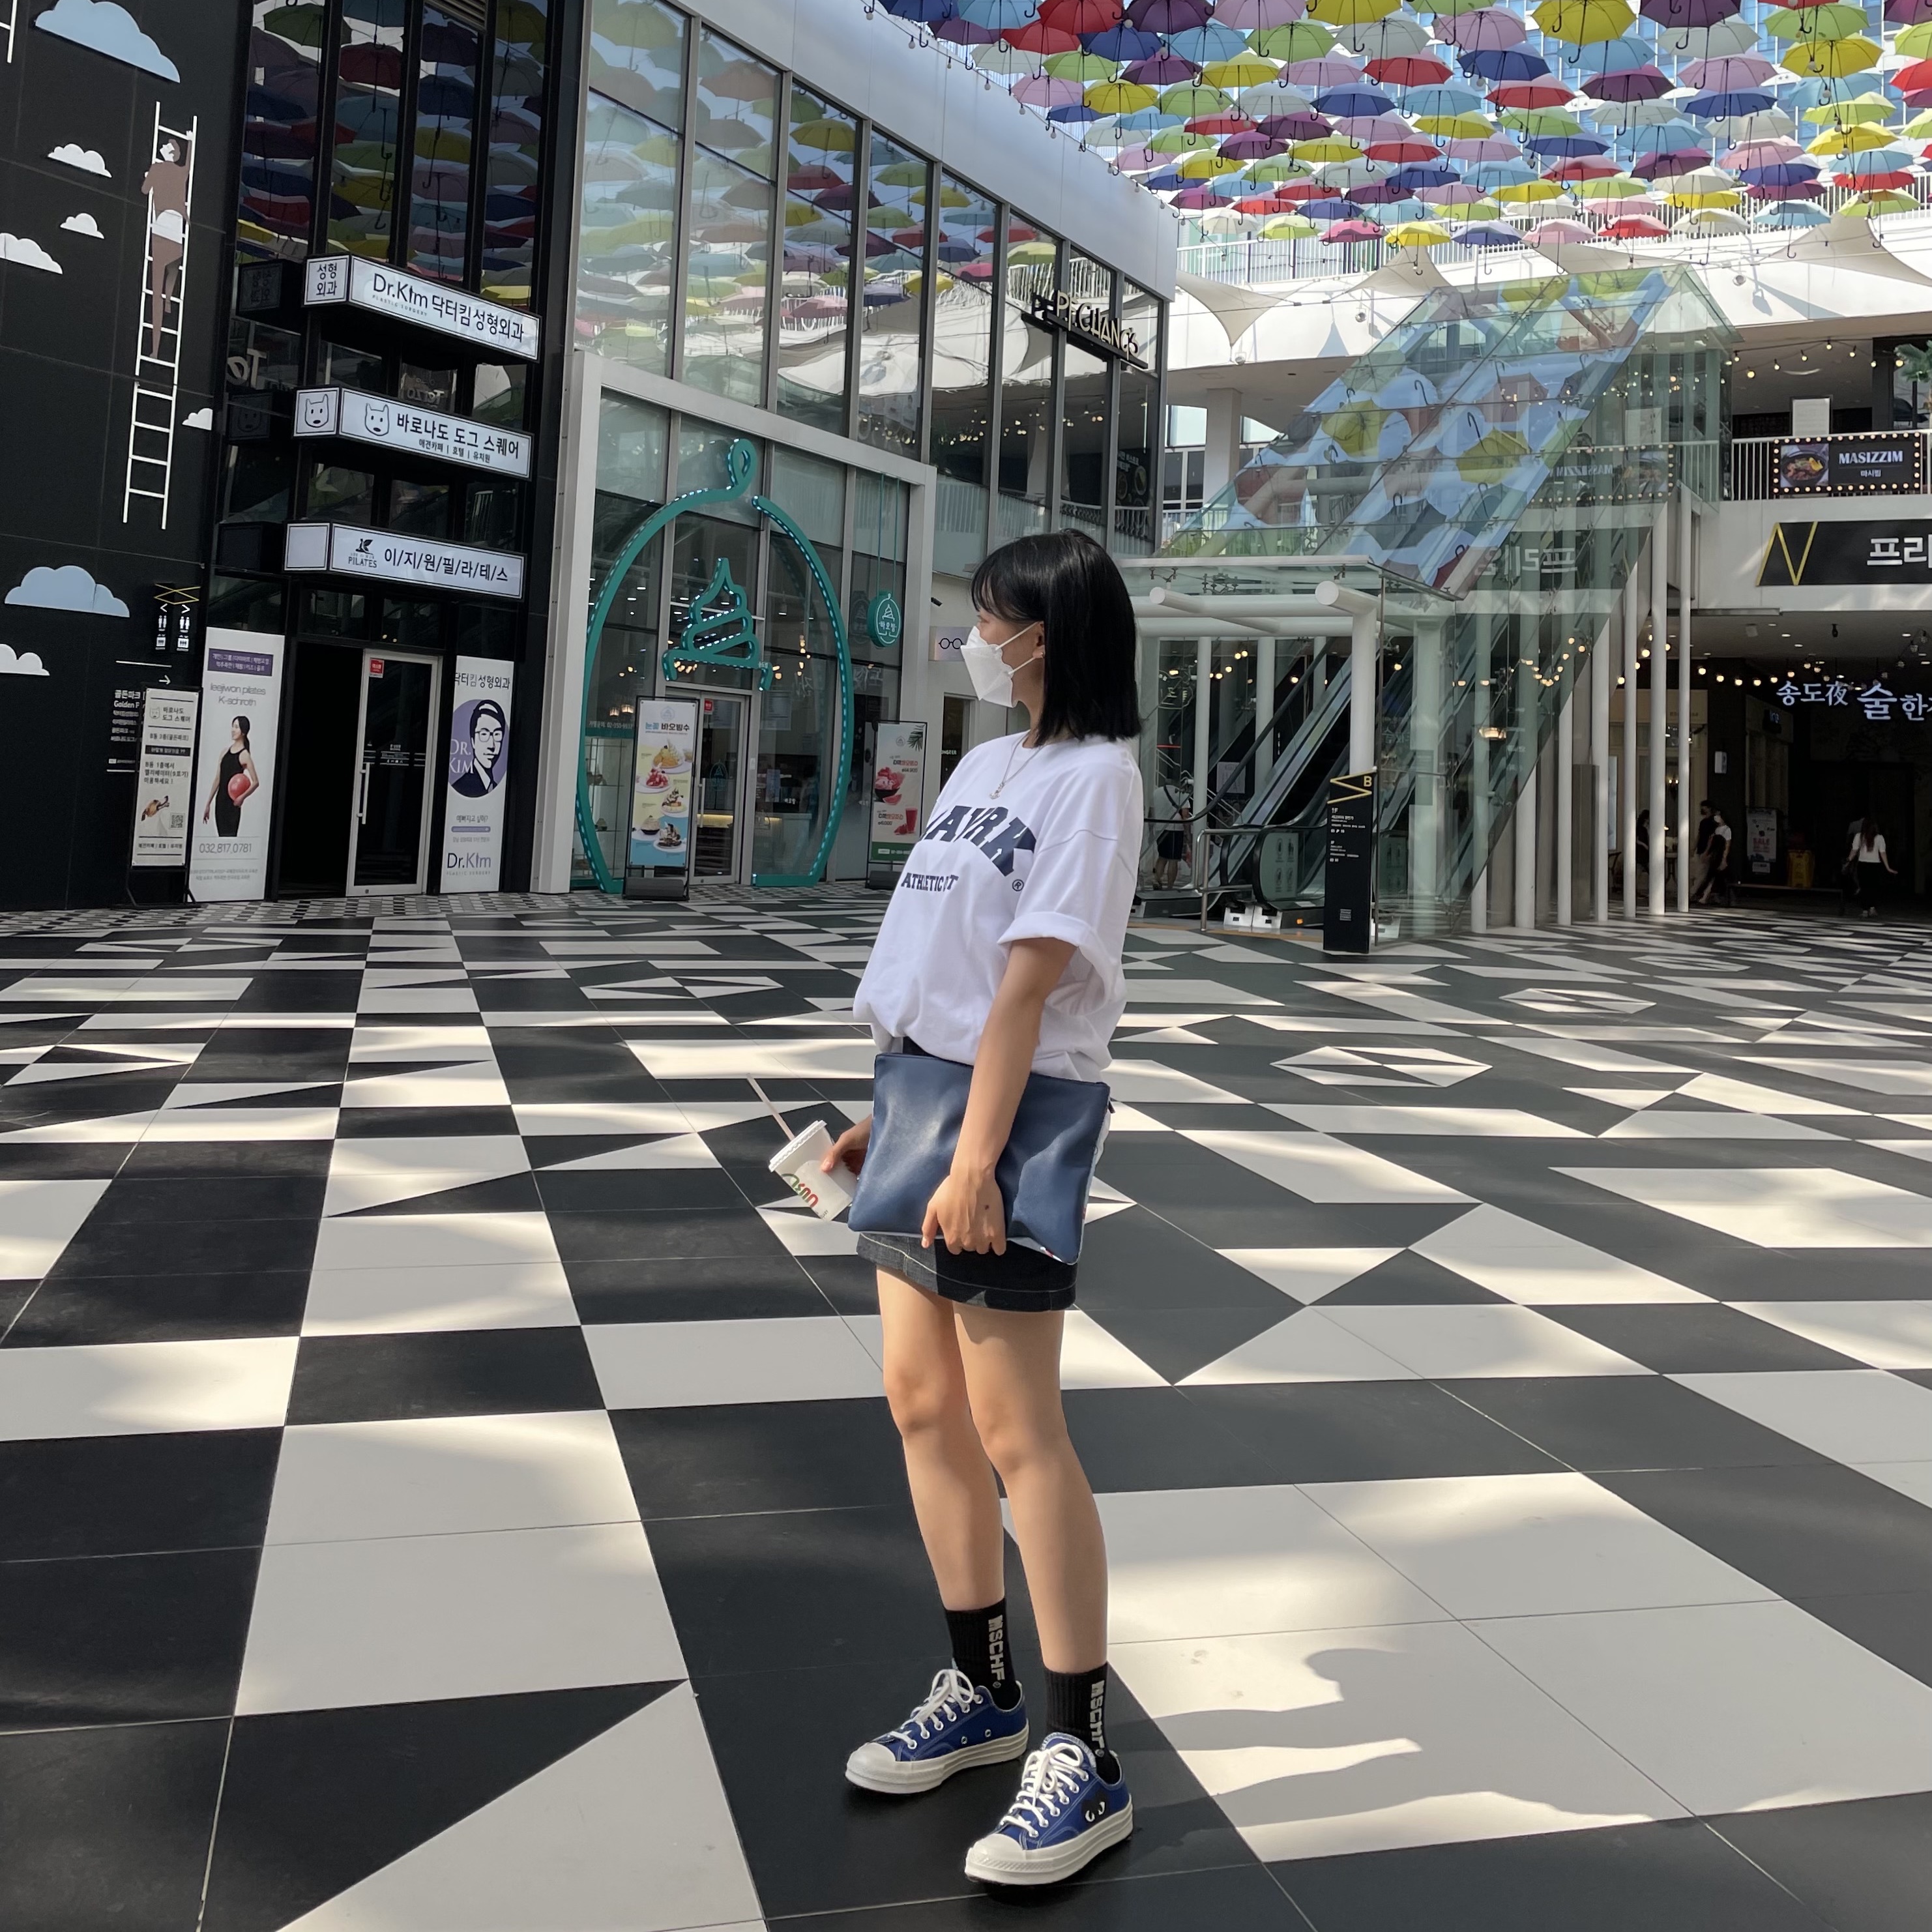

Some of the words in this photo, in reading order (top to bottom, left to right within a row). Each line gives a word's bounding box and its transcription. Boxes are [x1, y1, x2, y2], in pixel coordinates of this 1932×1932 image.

[317, 263, 338, 280] 성형
[316, 280, 338, 297] 외과
[431, 295, 525, 343] 닥터킴성형외과
[397, 413, 449, 441] 바로나도
[454, 428, 478, 448] 도그
[483, 435, 520, 460] 스퀘어
[419, 439, 443, 453] 애견카페
[452, 446, 464, 457] 호텔
[1839, 450, 1903, 464] MASIZZIM
[347, 555, 377, 569] PILATES
[1857, 682, 1897, 720] 술
[1363, 776, 1372, 787] B
